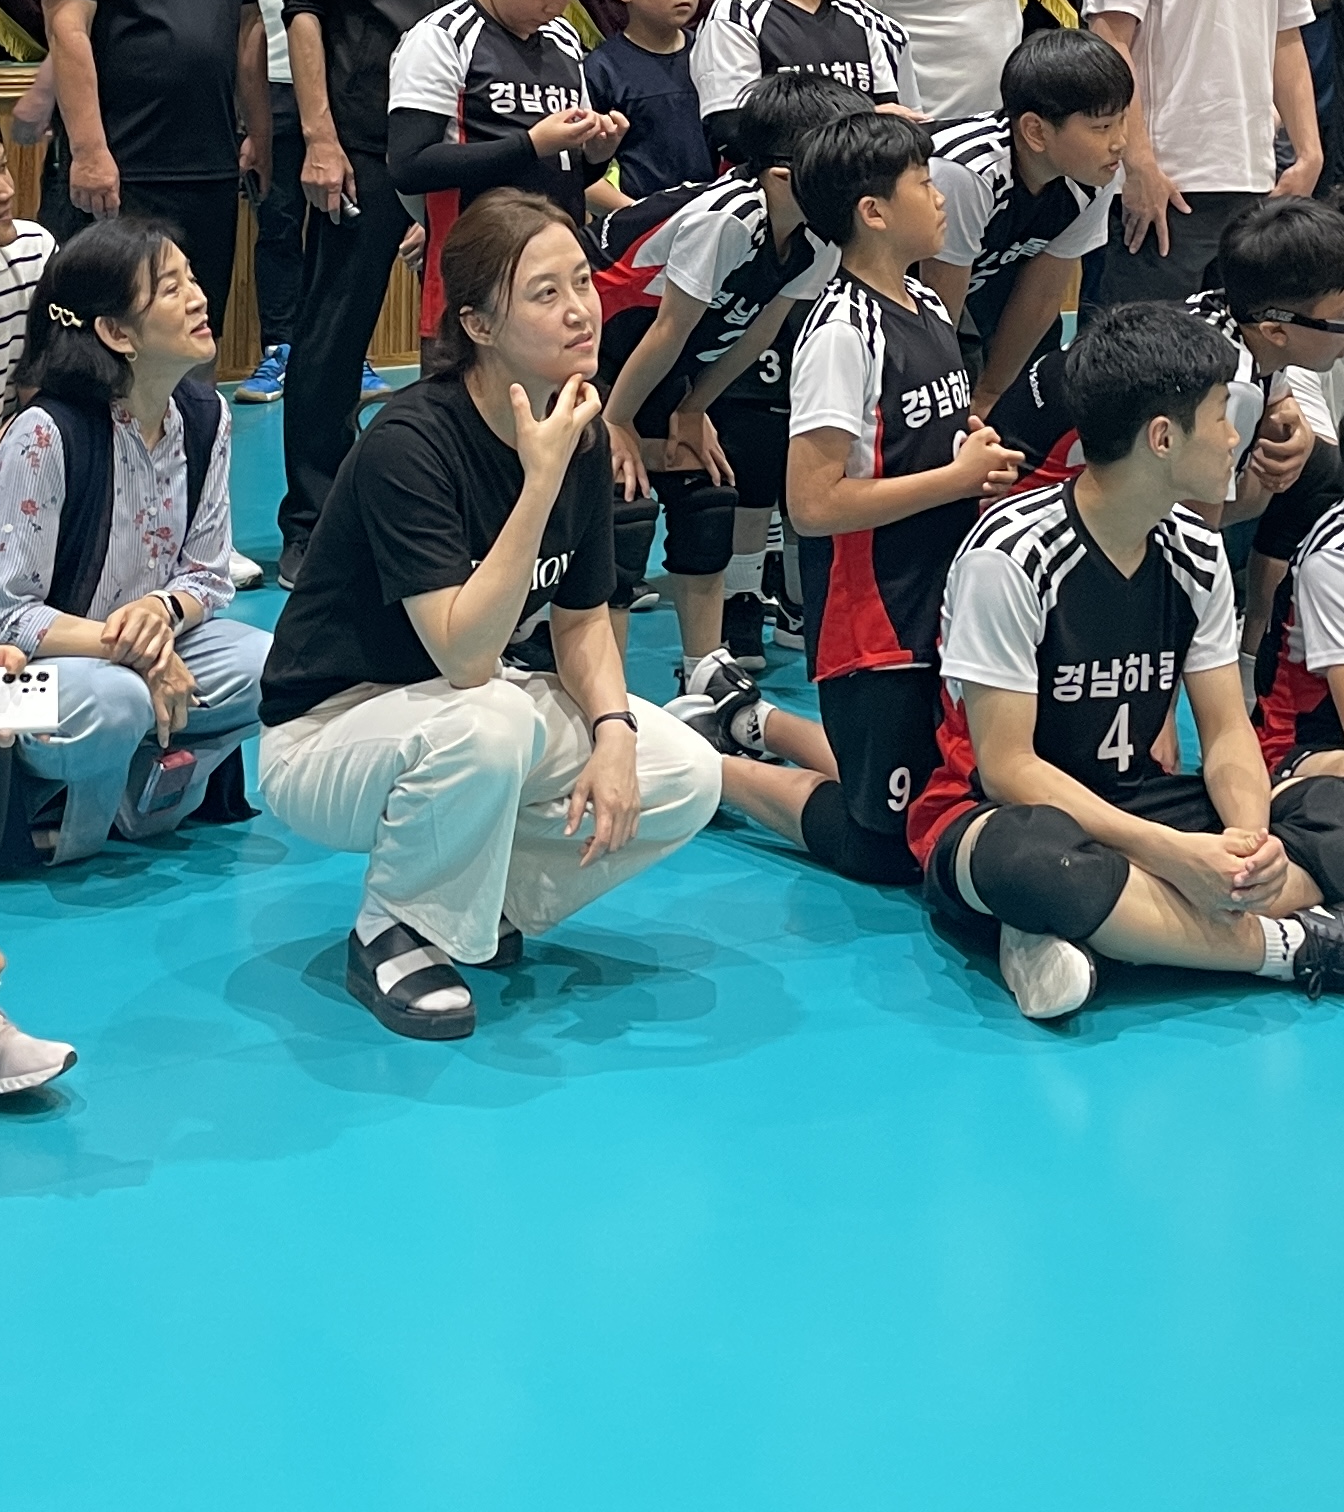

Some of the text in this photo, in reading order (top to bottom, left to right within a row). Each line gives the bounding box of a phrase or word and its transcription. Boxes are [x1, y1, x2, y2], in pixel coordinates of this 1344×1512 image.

[759, 349, 782, 384] 3
[901, 369, 971, 429] 경남하
[1097, 702, 1134, 773] 4
[887, 766, 911, 812] 9
